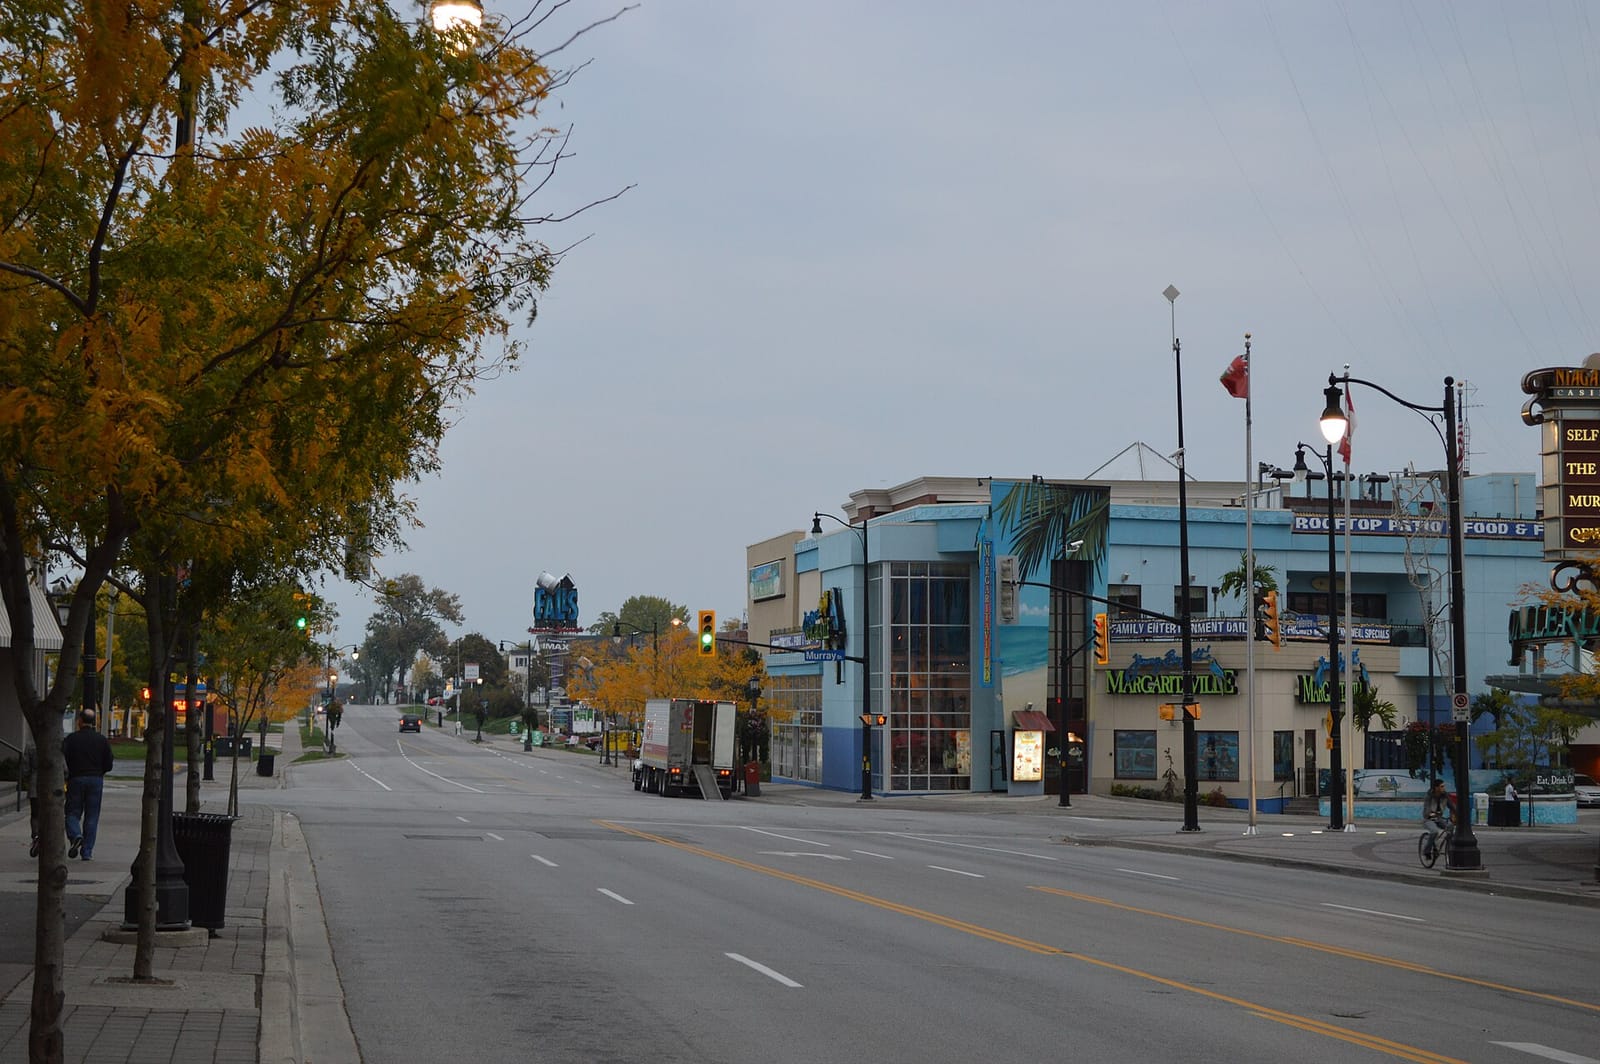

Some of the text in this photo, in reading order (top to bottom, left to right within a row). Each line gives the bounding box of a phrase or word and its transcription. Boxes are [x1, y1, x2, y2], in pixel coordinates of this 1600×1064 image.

[1557, 389, 1600, 397] CASI
[1567, 429, 1599, 442] SELF
[1566, 462, 1597, 475] THE
[1464, 523, 1508, 534] FOOD
[1515, 524, 1528, 535] &
[534, 588, 578, 620] FALLS
[1111, 623, 1144, 634] FAMILY
[542, 642, 569, 650] IMAX
[806, 651, 837, 662] Murray
